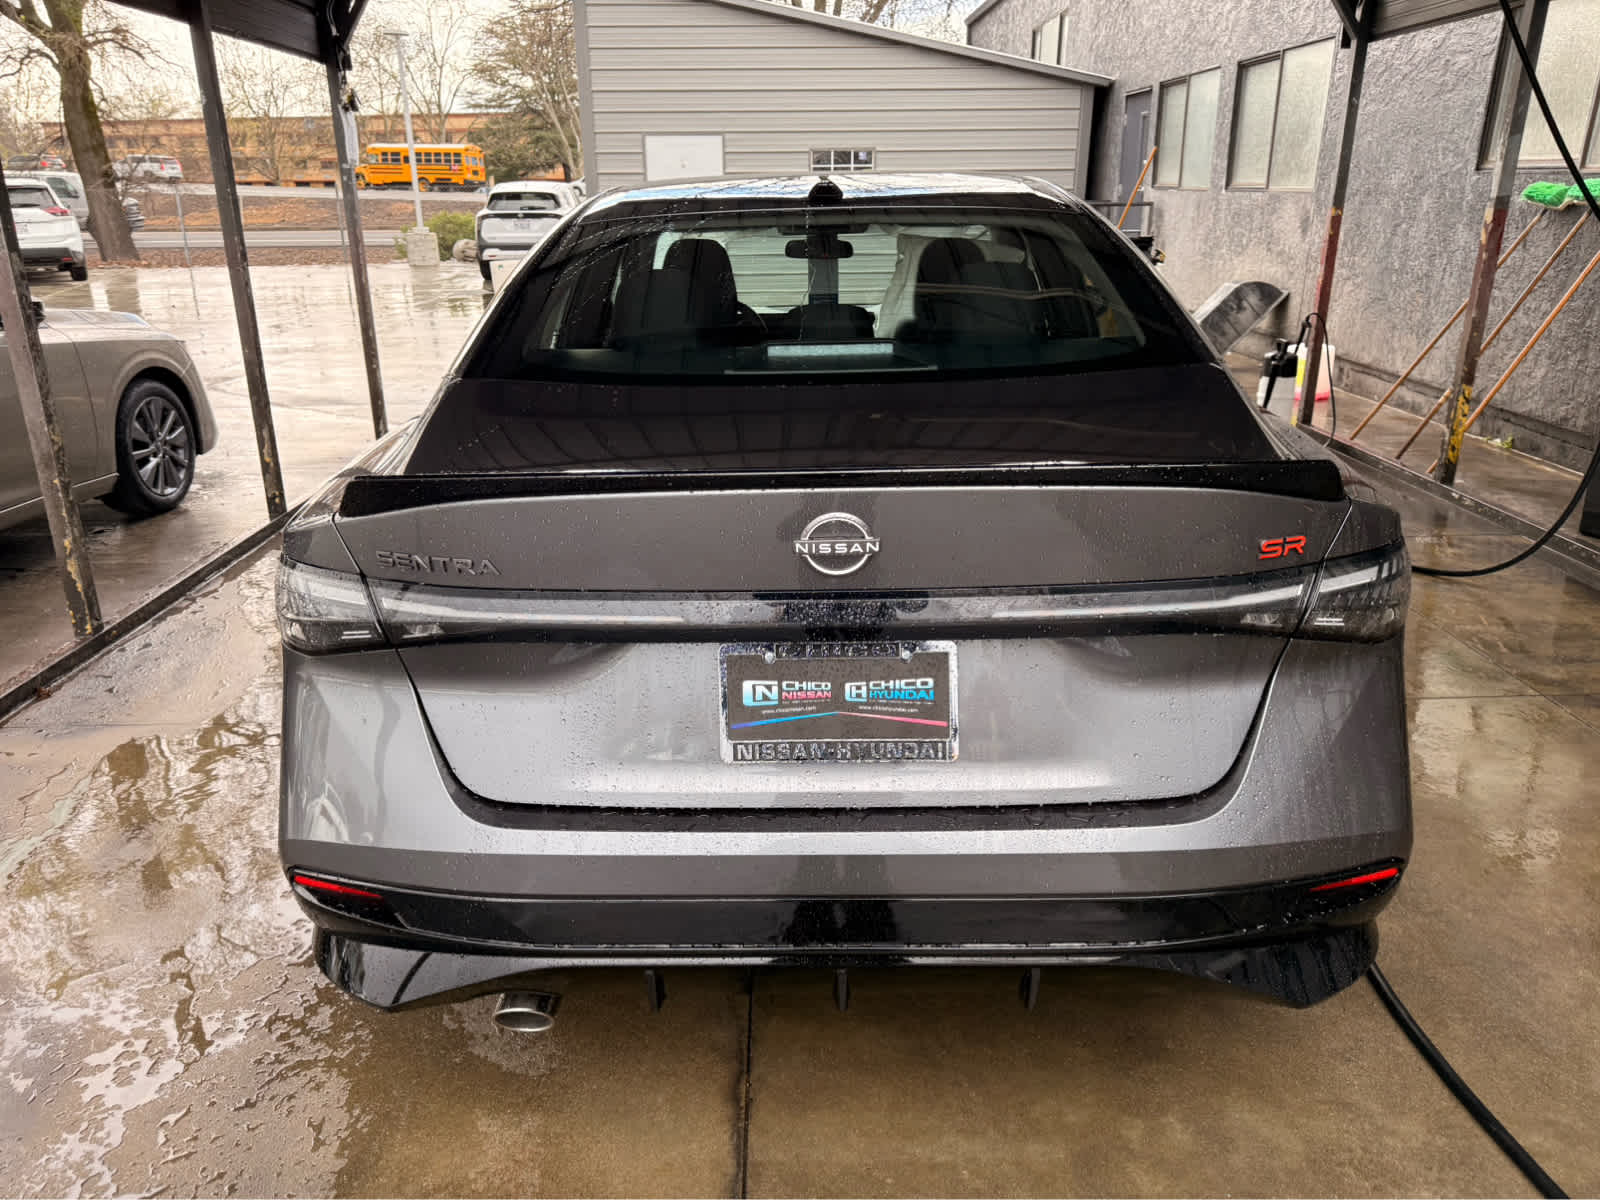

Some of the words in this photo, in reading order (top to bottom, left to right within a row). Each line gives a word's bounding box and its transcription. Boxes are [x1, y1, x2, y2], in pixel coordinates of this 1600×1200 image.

[795, 541, 880, 554] NISSAN
[1259, 535, 1307, 559] SR
[375, 550, 502, 575] SENTRA
[782, 681, 831, 691] CHICO
[869, 678, 934, 690] CHICO
[782, 691, 832, 700] NISSAN
[869, 689, 935, 701] HYUNDAI
